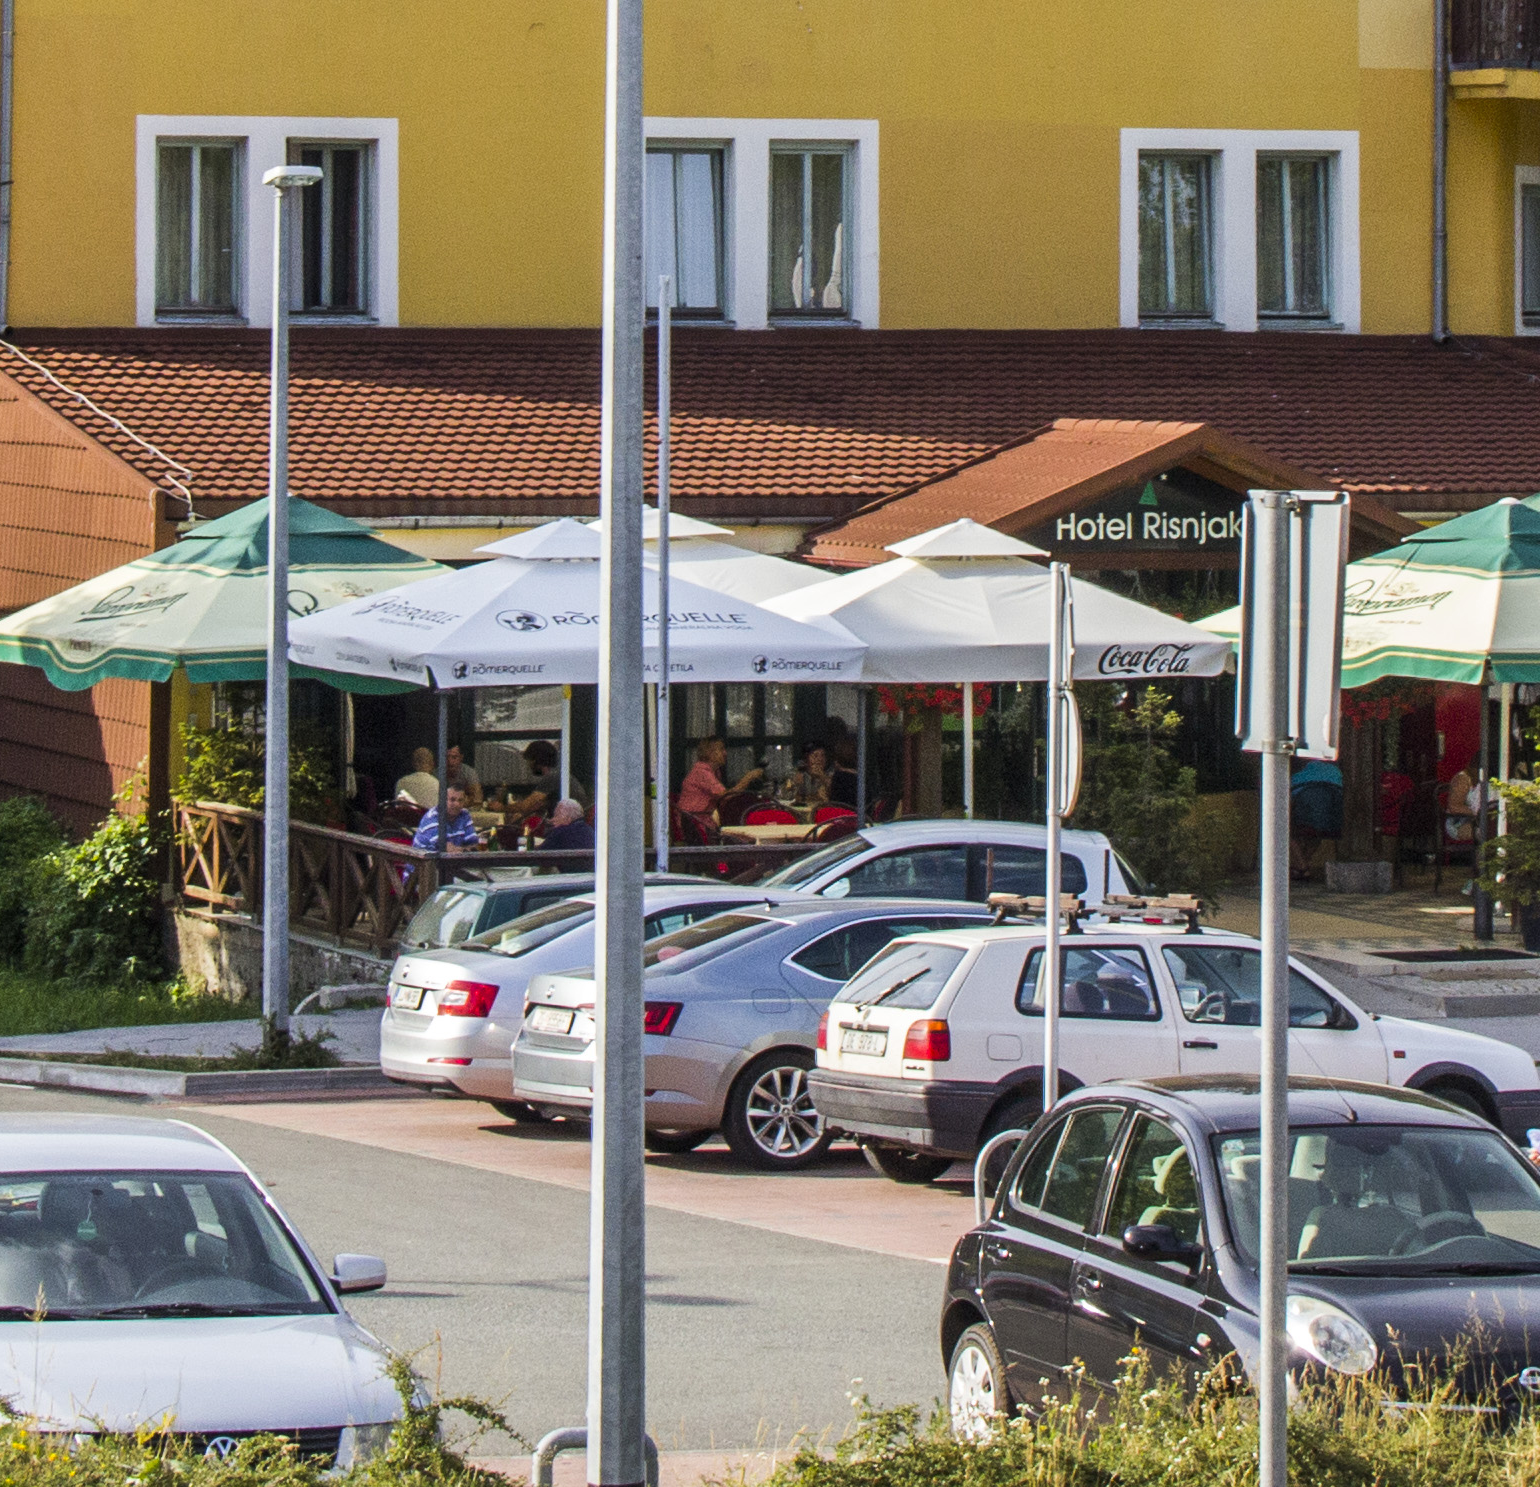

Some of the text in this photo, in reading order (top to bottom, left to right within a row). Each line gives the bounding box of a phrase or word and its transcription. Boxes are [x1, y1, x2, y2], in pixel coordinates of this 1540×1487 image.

[1056, 511, 1242, 545] Hotel Risnjak
[1098, 644, 1196, 675] Coca-Cola
